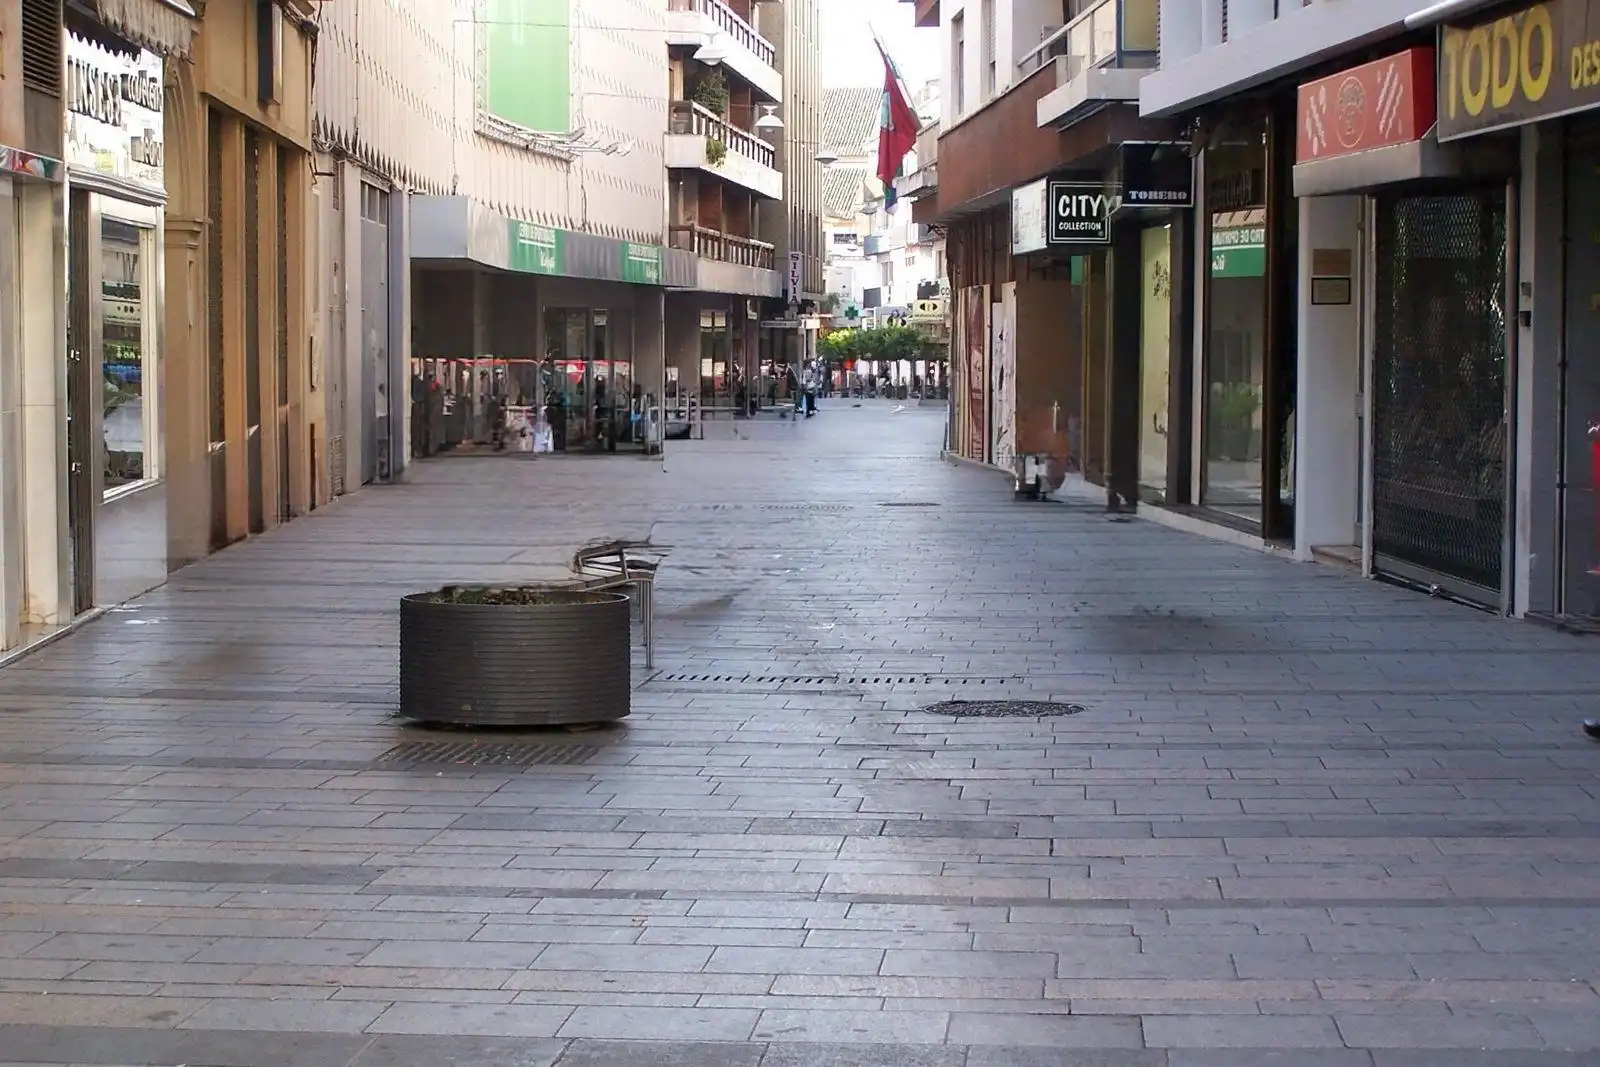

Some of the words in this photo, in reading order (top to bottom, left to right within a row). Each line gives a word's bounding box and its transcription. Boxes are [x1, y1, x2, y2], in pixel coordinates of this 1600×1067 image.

[1444, 4, 1553, 120] TODO
[1571, 40, 1600, 90] DES
[1058, 194, 1103, 218] CITY
[1128, 190, 1188, 200] TORERO
[1058, 221, 1102, 231] COLLECTION
[790, 253, 800, 304] SILVIA
